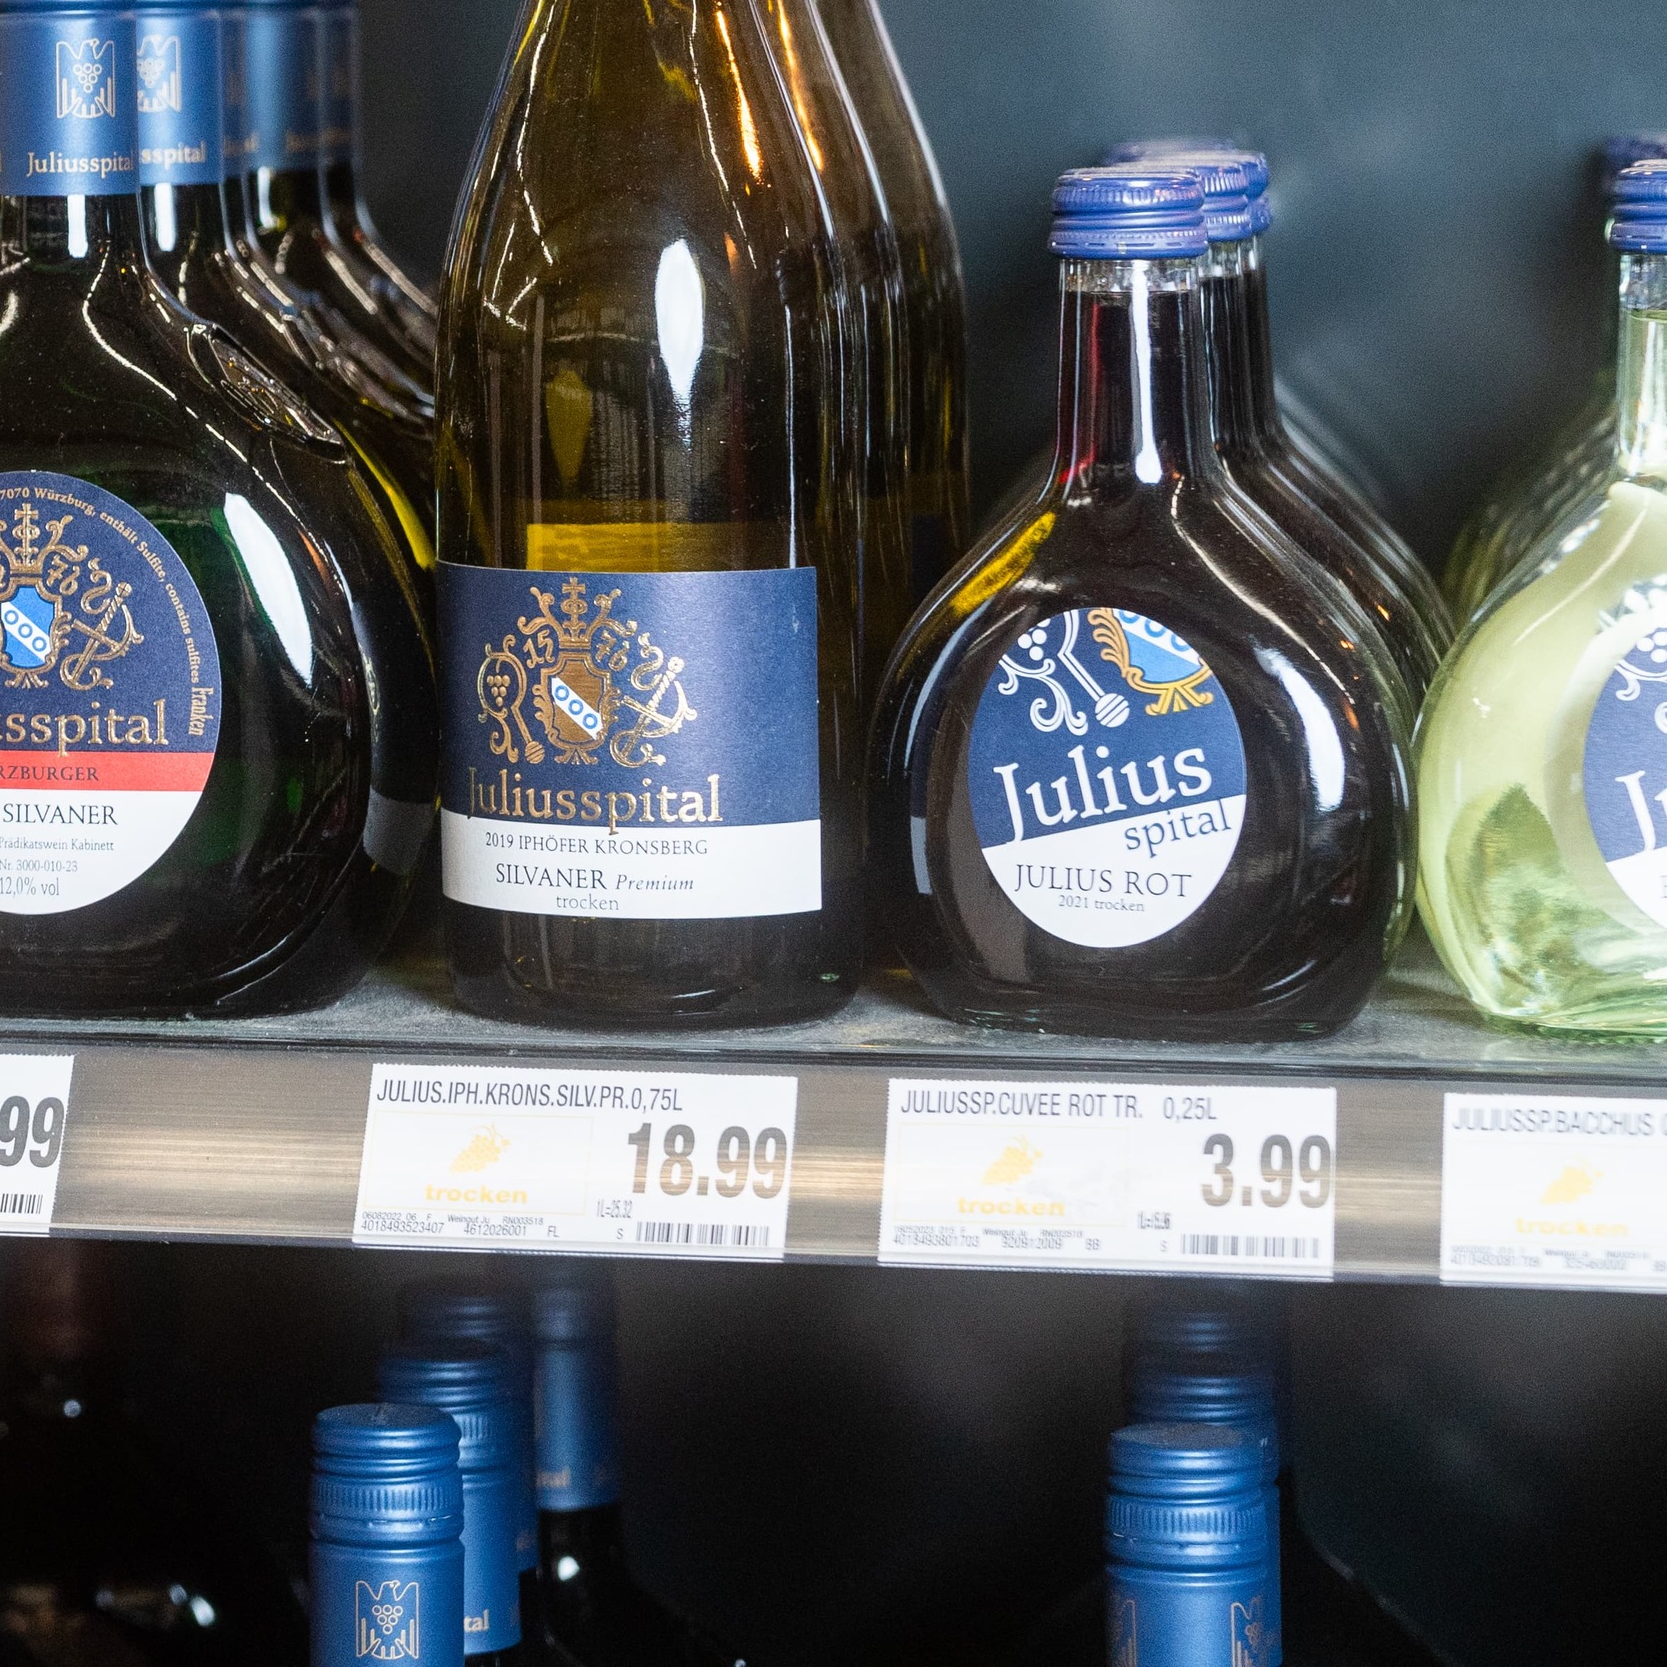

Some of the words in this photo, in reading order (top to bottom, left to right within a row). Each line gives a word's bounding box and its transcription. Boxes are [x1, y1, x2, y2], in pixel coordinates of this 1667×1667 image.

[26, 151, 134, 179] Juliusspital
[34, 487, 97, 517] Würzburg,
[99, 511, 138, 545] enthält
[136, 541, 167, 583] Sulfite,
[165, 583, 192, 635] contains
[185, 637, 201, 684] sulfites
[46, 554, 80, 596] 76
[523, 628, 555, 669] 15
[188, 686, 215, 736] Franken
[467, 766, 724, 836] Juliusspital
[993, 744, 1213, 843] Julius
[2, 802, 119, 826] SILVANER
[1123, 799, 1232, 858] spital
[71, 838, 115, 851] Kabinett
[485, 832, 514, 849] 2019
[519, 833, 589, 855] IPHÖFER
[595, 838, 709, 856] KRONSBERG
[16, 859, 78, 873] 3000-010-23
[495, 862, 608, 891] SILVANER
[615, 873, 695, 892] Premium
[0, 876, 37, 898] 12,0%
[40, 877, 60, 896] vol
[1015, 863, 1113, 893] JULIUS
[1123, 870, 1193, 898] ROT
[556, 894, 620, 911] trocken
[1058, 895, 1090, 910] 2021
[1094, 897, 1145, 913] trocken
[376, 1078, 683, 1113] JULIUS.IPH.KRONS.SILV.PR.0,75L
[900, 1090, 1062, 1116] JULIUSSP.CUVEE
[1068, 1093, 1106, 1118] ROT
[1112, 1094, 1144, 1119] TR.
[1163, 1096, 1217, 1123] 0,25L
[1452, 1108, 1654, 1136] JULIUSSP.BACCHUS
[627, 1122, 788, 1200] 18.99
[1200, 1132, 1332, 1209] 3.99
[424, 1183, 528, 1205] trocken
[957, 1196, 1065, 1217] trocken
[361, 1220, 445, 1234] 4018493523407
[463, 1223, 527, 1237] 4612026001
[547, 1226, 560, 1238] FL
[447, 1213, 478, 1225] Weingut
[502, 1216, 544, 1225] RN003518
[1515, 1218, 1629, 1237] trocken
[616, 1228, 624, 1240] S
